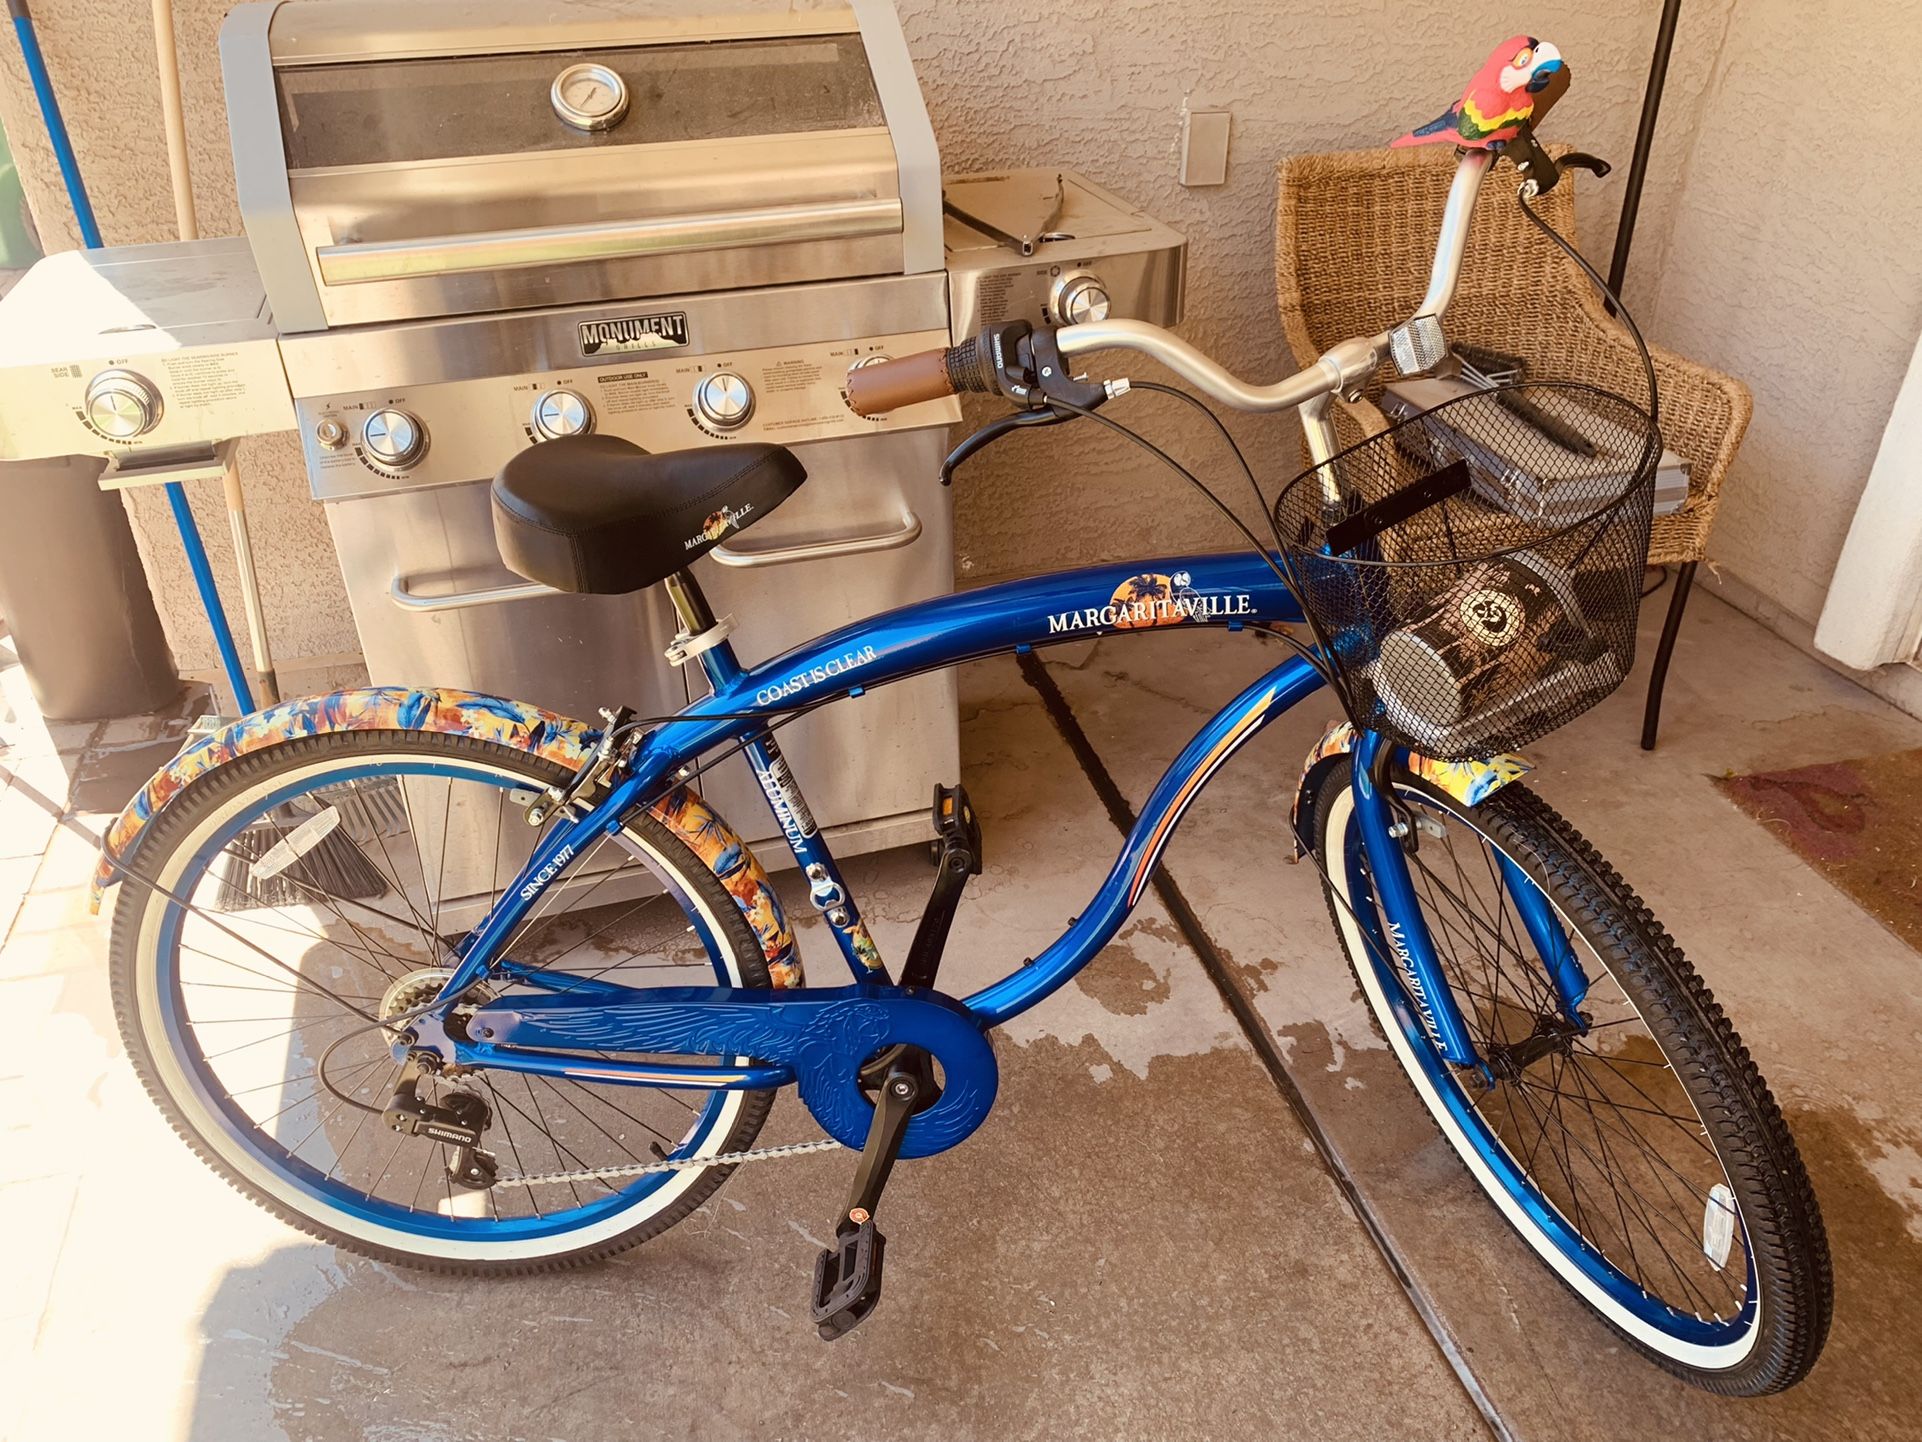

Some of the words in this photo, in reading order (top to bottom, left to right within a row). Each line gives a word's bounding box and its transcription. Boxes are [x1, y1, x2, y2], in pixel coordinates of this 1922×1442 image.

[581, 315, 683, 345] MONUMENT
[993, 333, 1004, 369] SHIMANO
[1047, 594, 1251, 634] MARGARITAVILLE
[756, 676, 809, 706] COAST
[809, 666, 826, 688] IS
[825, 644, 877, 676] CLEAR
[756, 769, 807, 854] ALUMINUM
[520, 862, 558, 901] SINCE
[552, 844, 575, 867] 1977
[1388, 921, 1449, 1052] MARGARITAVILLE
[427, 1126, 473, 1144] SHIMANO
